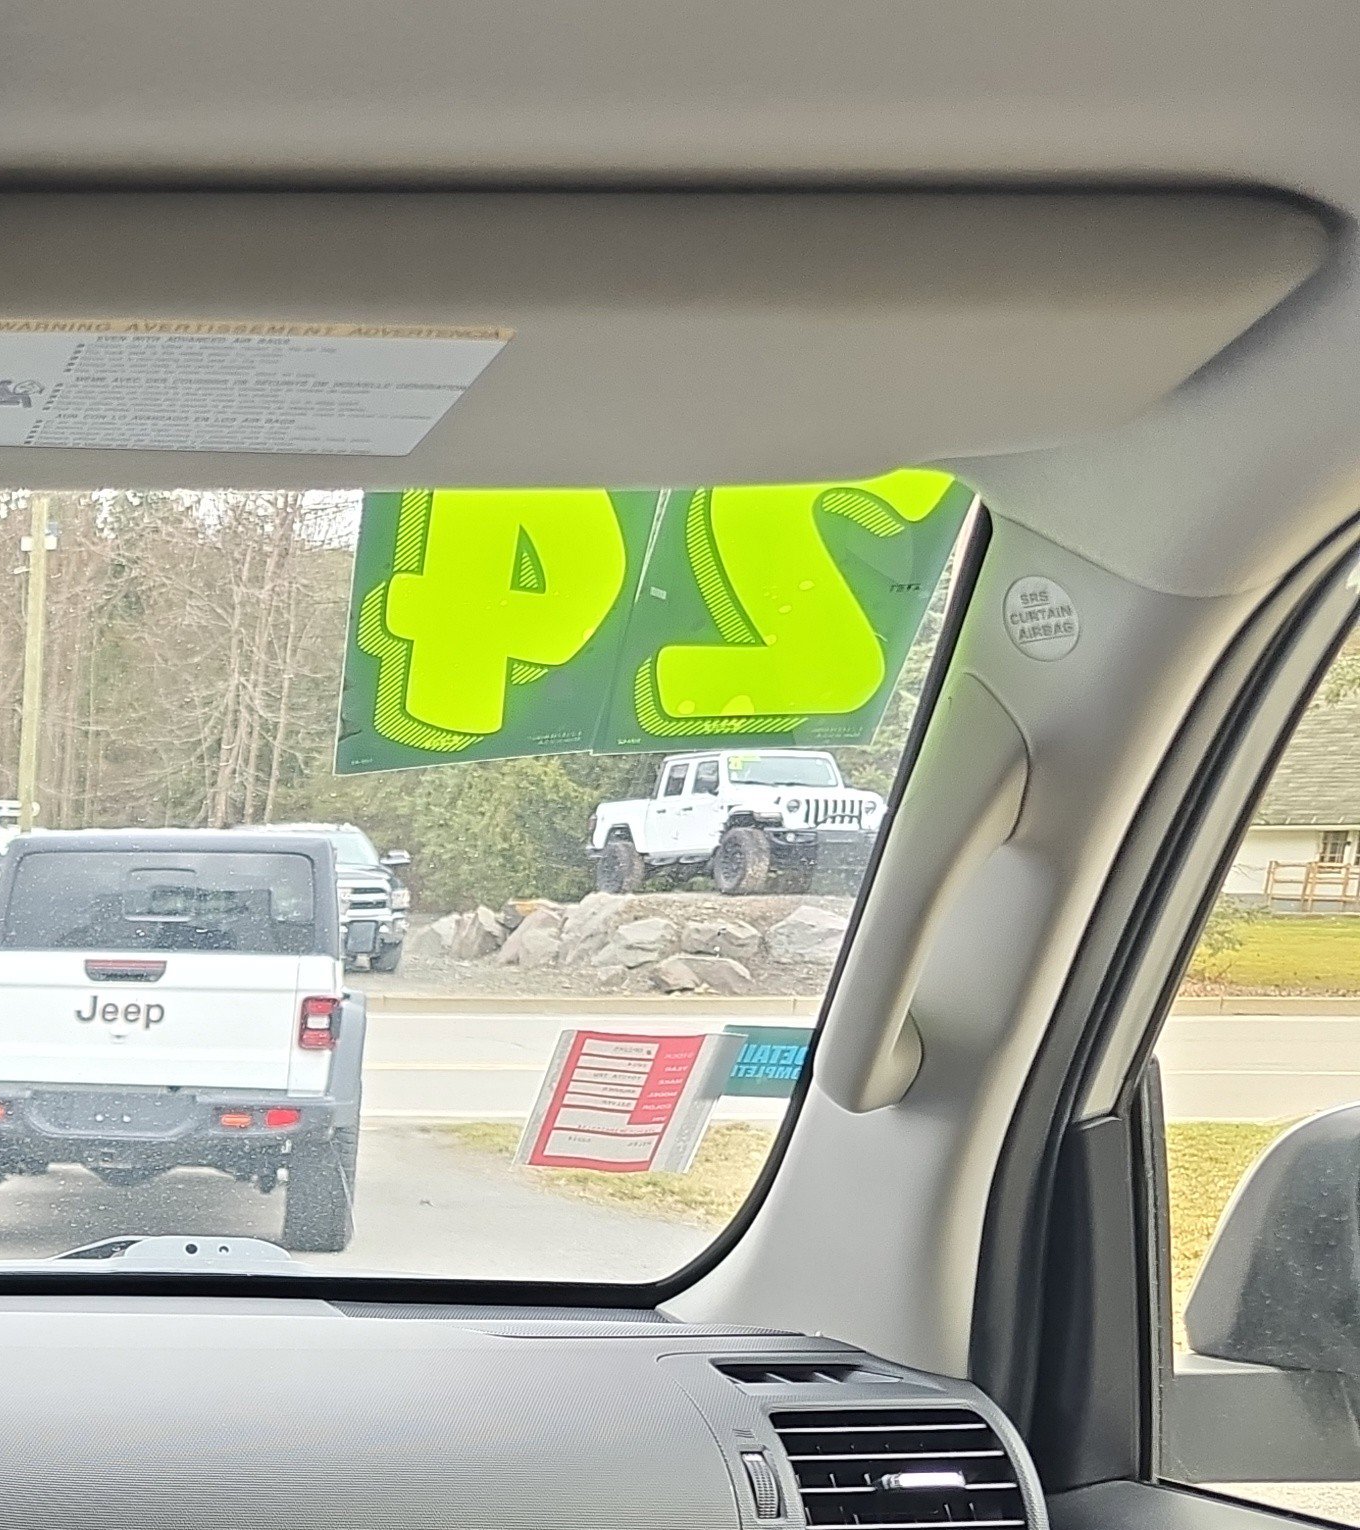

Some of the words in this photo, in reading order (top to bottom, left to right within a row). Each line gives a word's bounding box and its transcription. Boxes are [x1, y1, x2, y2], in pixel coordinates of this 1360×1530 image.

[1020, 591, 1049, 604] SRS
[1010, 605, 1072, 625] CURTAIN
[1019, 622, 1074, 640] AIRBAG
[75, 996, 166, 1029] Jeep
